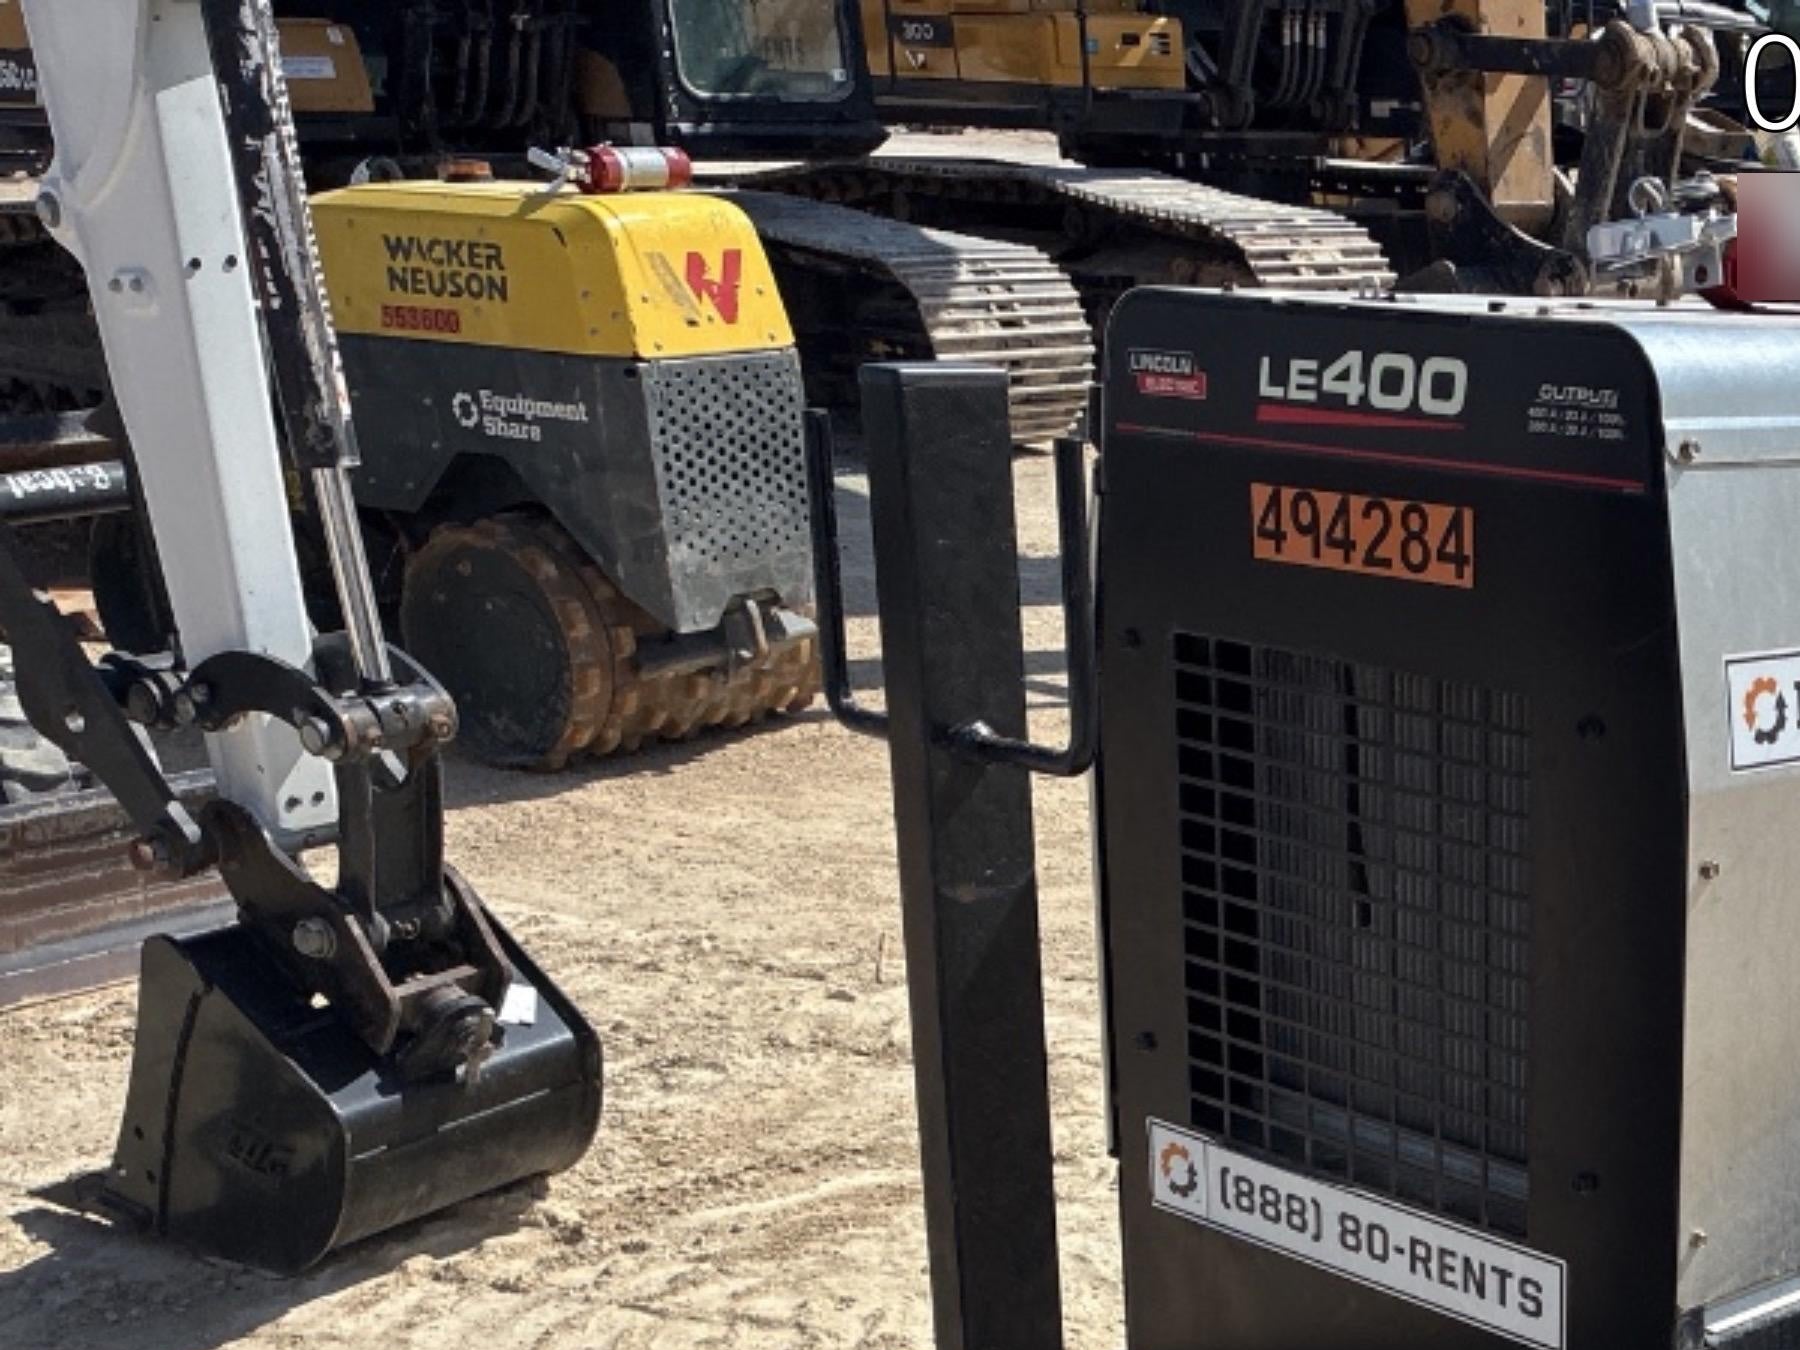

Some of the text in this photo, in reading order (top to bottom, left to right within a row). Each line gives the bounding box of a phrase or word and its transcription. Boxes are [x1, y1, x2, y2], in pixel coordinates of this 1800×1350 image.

[386, 266, 508, 302] NEUSON
[481, 390, 589, 423] Equipment
[1258, 350, 1468, 416] LE400
[483, 415, 541, 441] Share
[1257, 487, 1471, 580] 494284
[1220, 1166, 1545, 1319] (888) 80-RENTS
